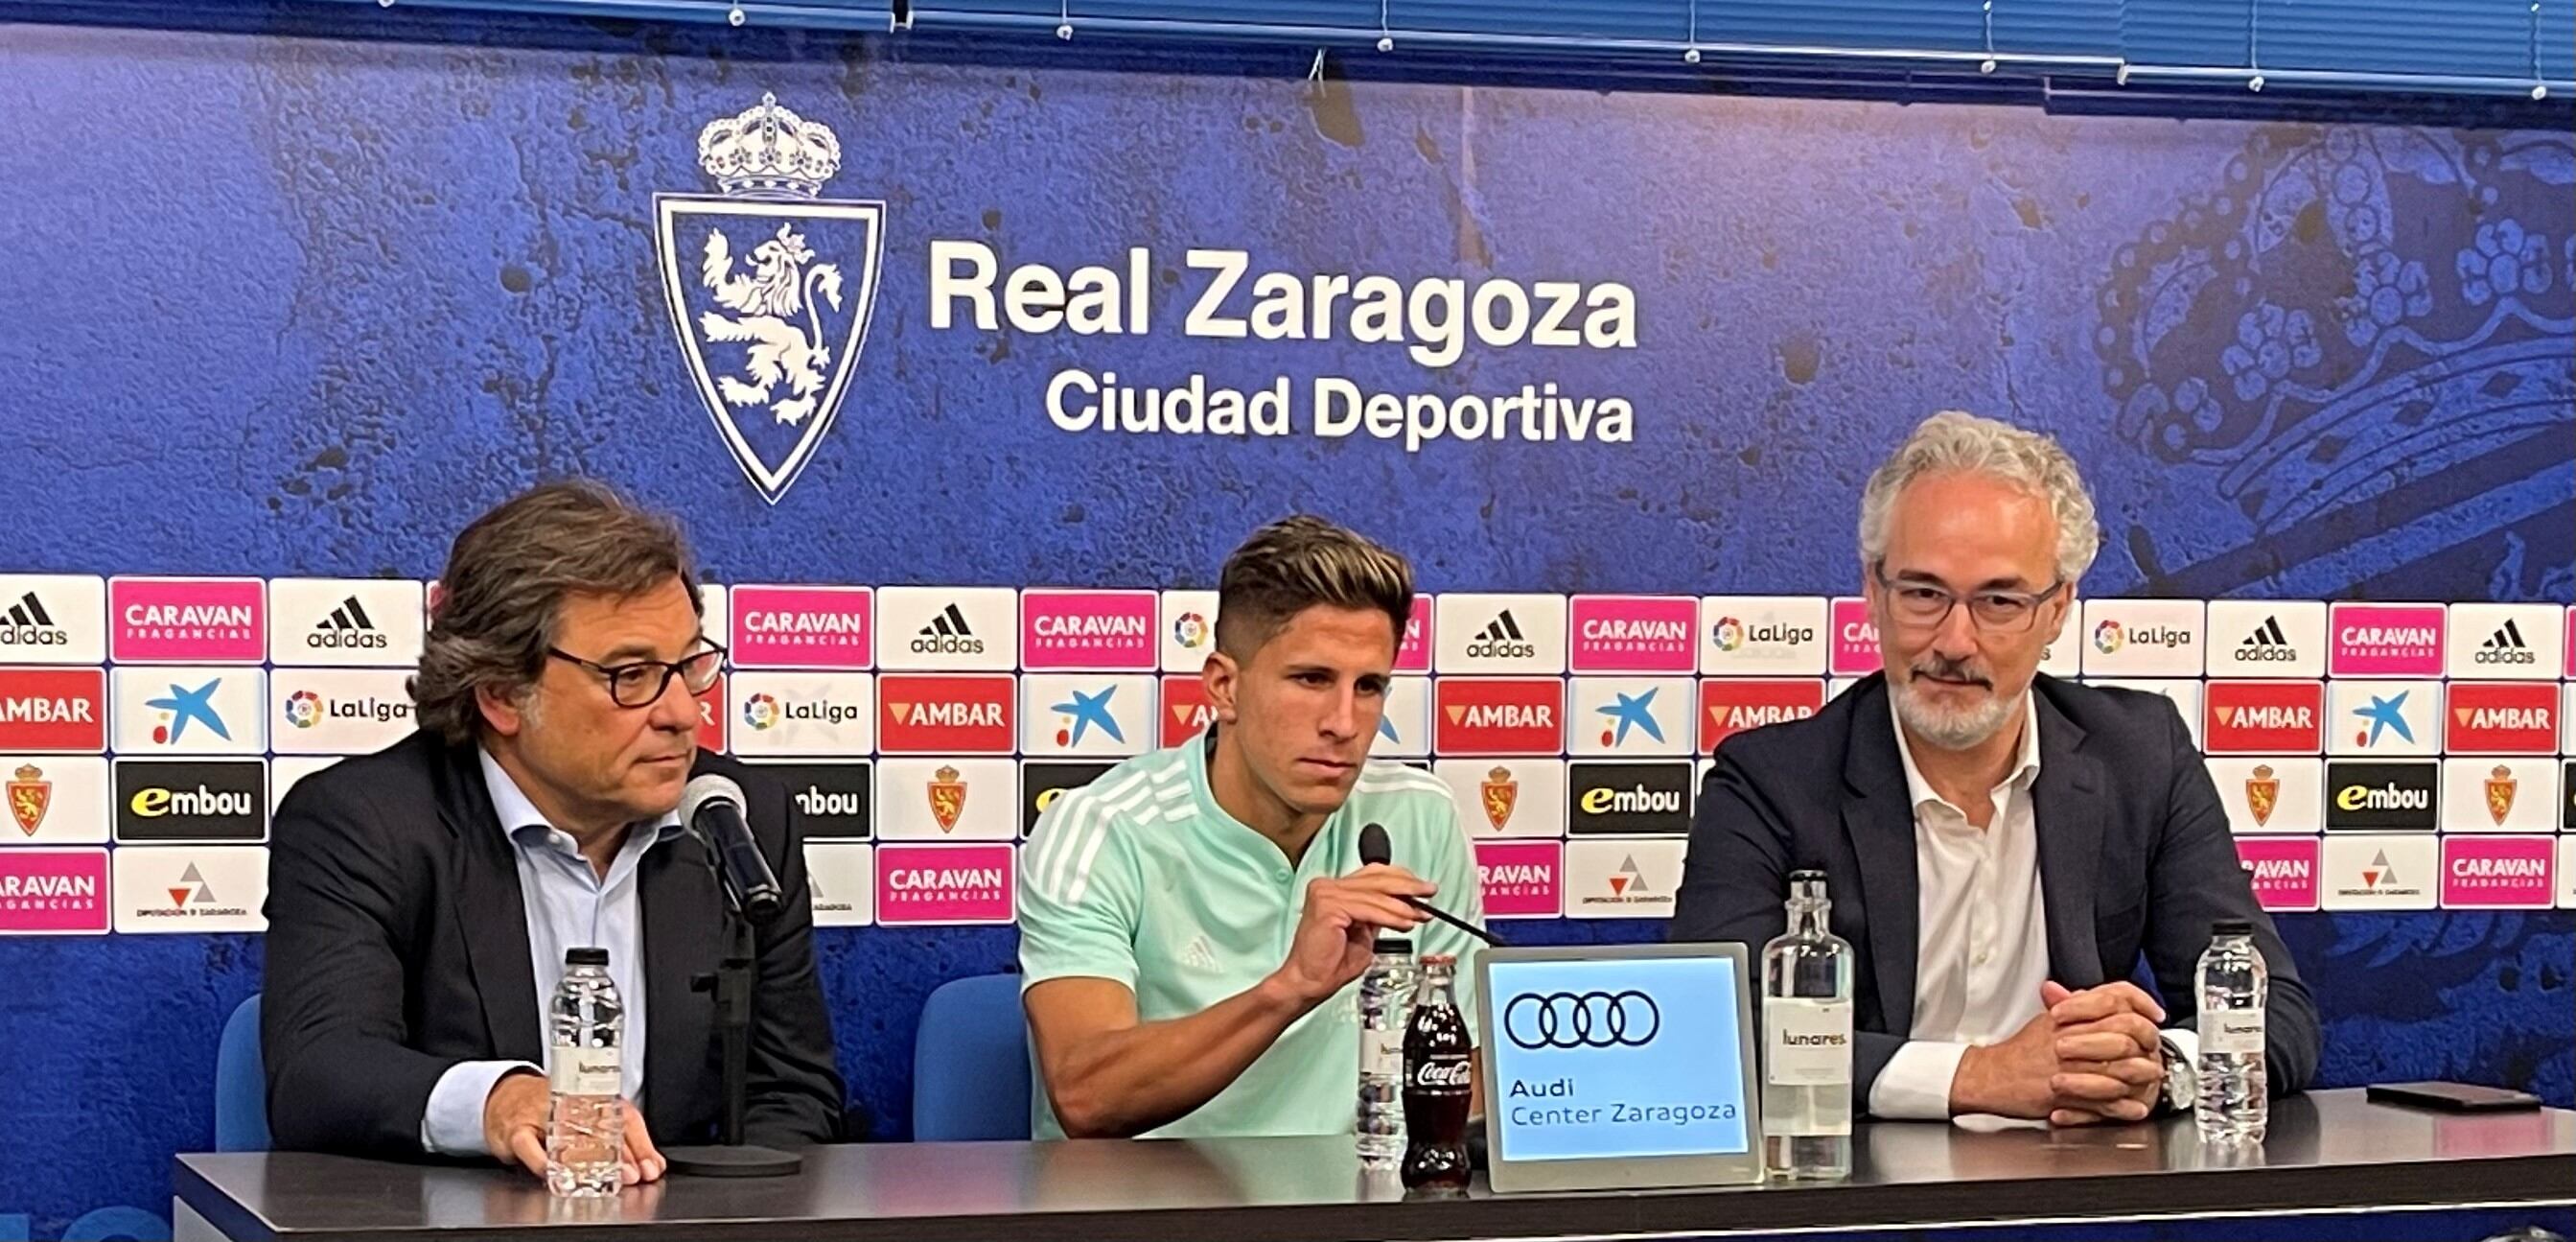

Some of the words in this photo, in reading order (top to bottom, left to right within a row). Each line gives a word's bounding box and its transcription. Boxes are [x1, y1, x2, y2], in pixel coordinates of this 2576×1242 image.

[929, 240, 1149, 335] Real
[1185, 248, 1637, 367] Zaragoza
[1046, 369, 1290, 436] Ciudad
[1314, 378, 1633, 451] Deportiva
[126, 604, 251, 626] CARAVAN
[745, 611, 860, 633] CARAVAN
[0, 624, 67, 645] didas
[128, 628, 250, 639] FRAGANCIAS
[308, 625, 387, 648] adidas
[1034, 616, 1146, 636] CARAVAN
[1583, 620, 1686, 640] CARAVAN
[1749, 622, 1813, 645] LaLiga
[2128, 626, 2191, 647] LaLiga
[2341, 627, 2436, 645] CARAVAN
[746, 634, 859, 645] FRAGANCIAS
[911, 636, 984, 653] adidas
[1035, 638, 1145, 648] FRAGANCIAS
[1467, 640, 1534, 658] adidas
[1584, 642, 1685, 651] FRAGANCIAS
[2235, 644, 2296, 661] adidas
[2474, 646, 2535, 664] adidas
[331, 697, 407, 721] LaLiga
[786, 700, 858, 723] LaLiga
[910, 702, 1005, 727] AMBAR
[1465, 705, 1553, 728] AMBAR
[2232, 707, 2313, 729] AMBAR
[2472, 708, 2551, 729] AMBAR
[131, 785, 251, 817] embou
[1582, 785, 1680, 813] embou
[2337, 782, 2428, 809] embou
[1477, 865, 1551, 884] RAVAN
[2453, 858, 2545, 877] CARAVAN
[0, 875, 95, 897] RAVAN
[890, 868, 1002, 890] CARAVAN
[0, 899, 93, 910] GANCIAS
[890, 890, 1001, 902] FRAGANCIAS
[1783, 1028, 1846, 1045] lunares
[1510, 1078, 1574, 1097] Audi
[1511, 1106, 1601, 1126] Center
[1612, 1103, 1736, 1126] Zaragoza
